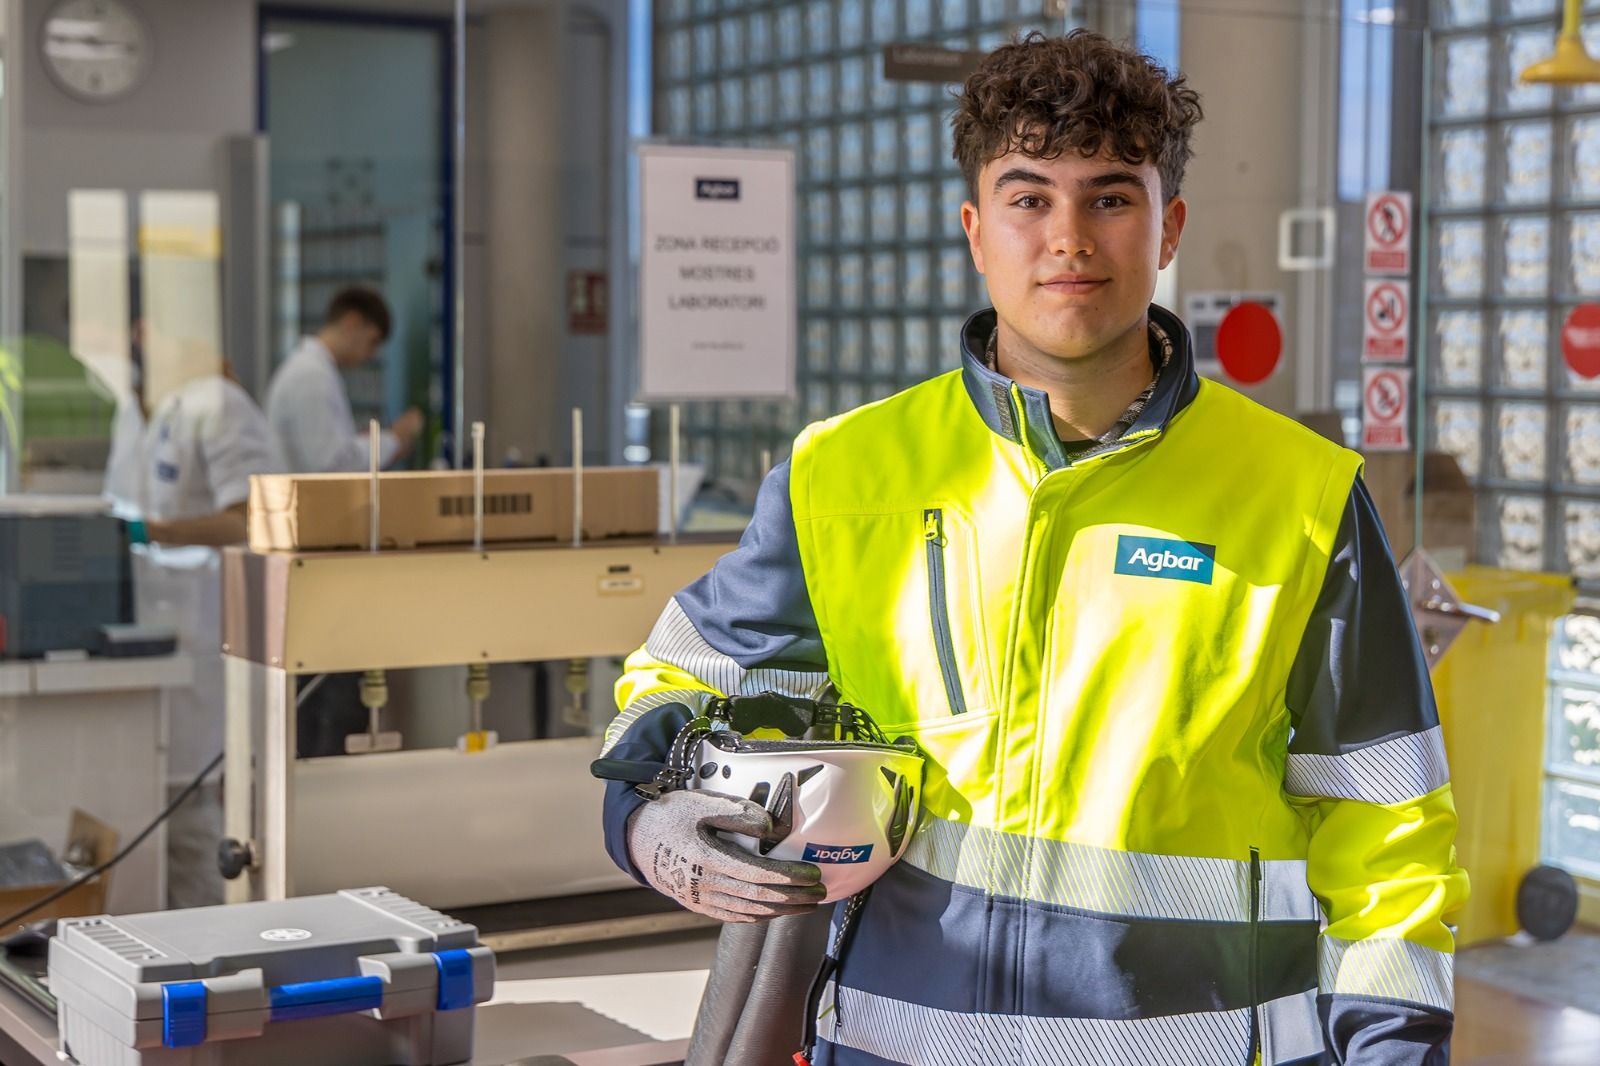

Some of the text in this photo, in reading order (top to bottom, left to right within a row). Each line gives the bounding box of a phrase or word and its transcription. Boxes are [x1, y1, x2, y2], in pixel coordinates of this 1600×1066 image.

[655, 235, 696, 252] ZONA
[679, 265, 755, 281] MOSTRES
[668, 294, 766, 311] LABORATORI
[1128, 547, 1204, 572] Agbar
[812, 848, 865, 861] Agbar
